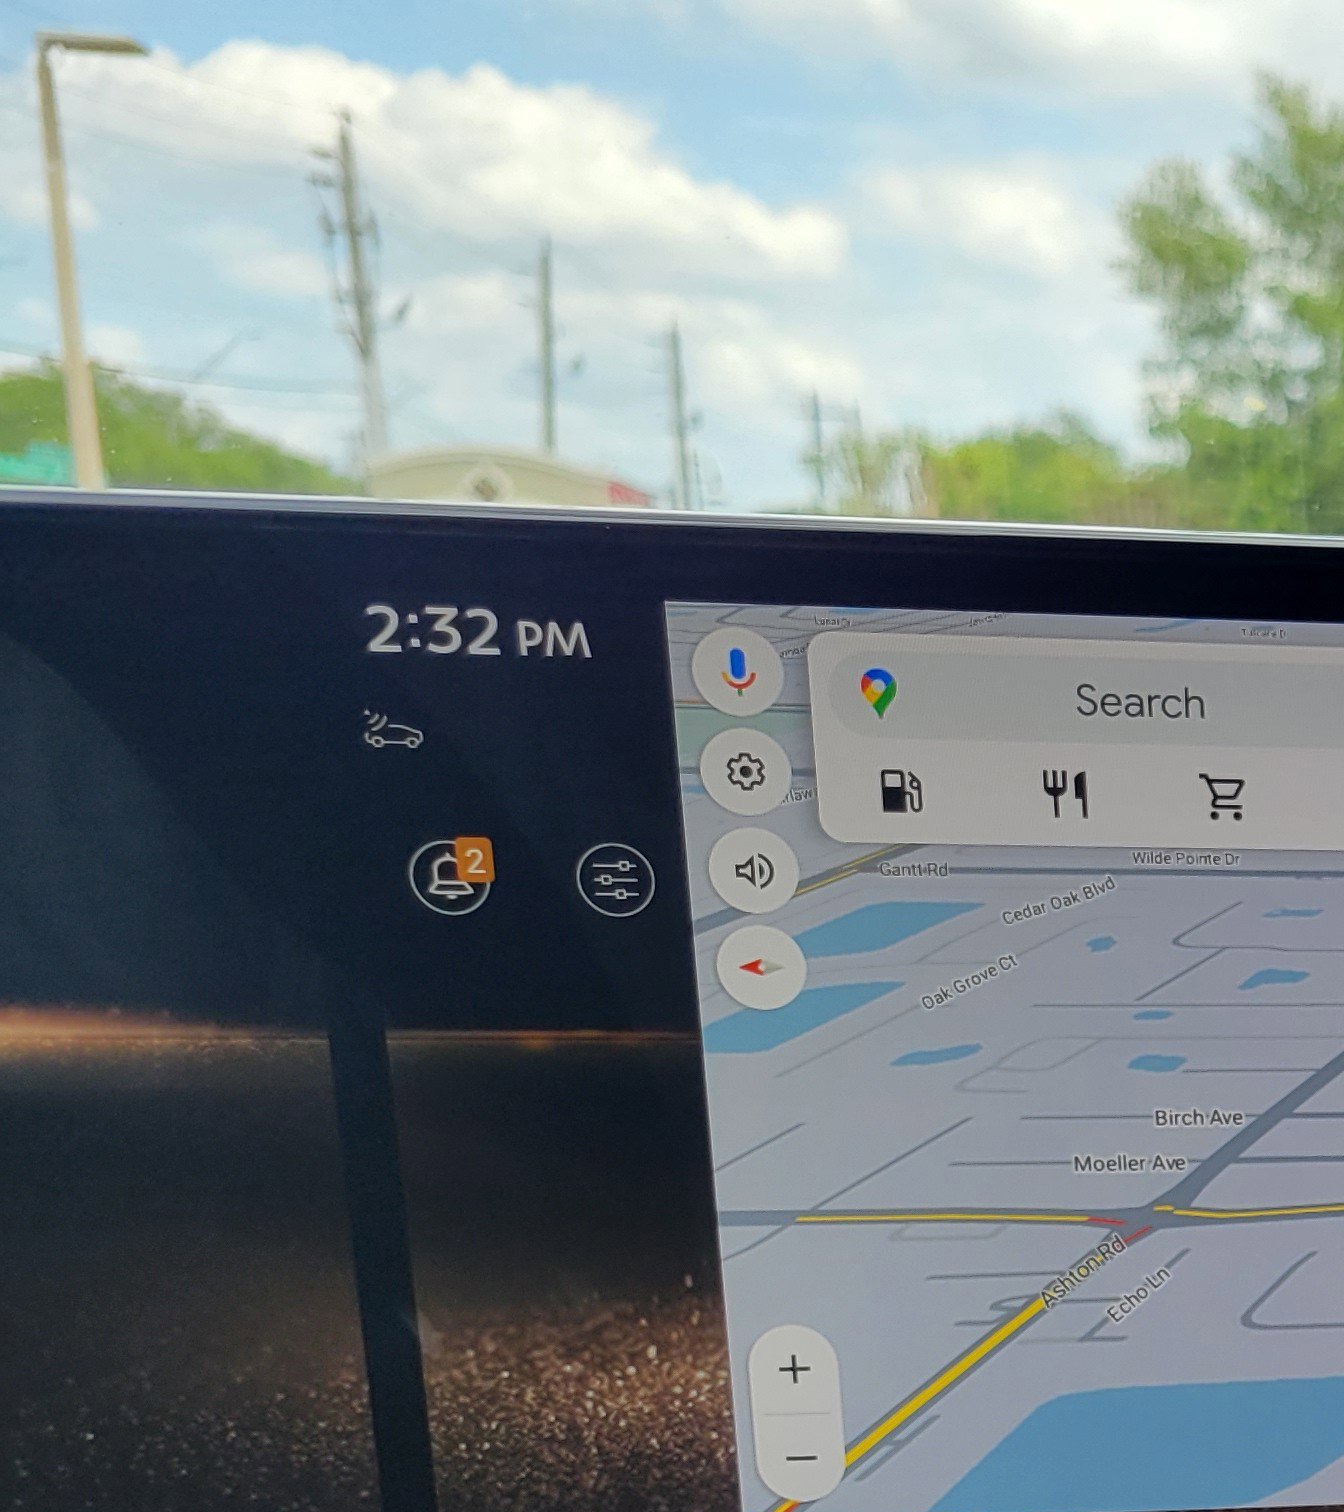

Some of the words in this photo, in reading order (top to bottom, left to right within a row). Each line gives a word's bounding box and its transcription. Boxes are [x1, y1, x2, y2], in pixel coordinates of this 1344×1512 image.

[364, 604, 502, 656] 2:32
[516, 620, 594, 659] PM
[1076, 684, 1206, 719] Search
[464, 848, 488, 875] 2
[879, 861, 924, 877] Gantt
[927, 862, 949, 877] Rd
[1132, 850, 1173, 866] Wilde
[1175, 851, 1222, 866] Pointe
[1224, 852, 1241, 867] Dr
[1001, 901, 1048, 925] Cedar
[1049, 891, 1082, 911] Oak
[1082, 876, 1118, 900] Blvd
[921, 986, 954, 1010] Oak
[953, 963, 999, 997] Grove
[998, 953, 1018, 972] Ct
[1154, 1109, 1205, 1126] Birch
[1209, 1109, 1244, 1126] Ave
[1073, 1154, 1146, 1172] Moeller
[1151, 1154, 1187, 1171] Ave
[1040, 1255, 1102, 1309] Ashton
[1097, 1234, 1128, 1265] Rd
[1106, 1286, 1150, 1324] Echo
[1145, 1265, 1172, 1293] Ln
